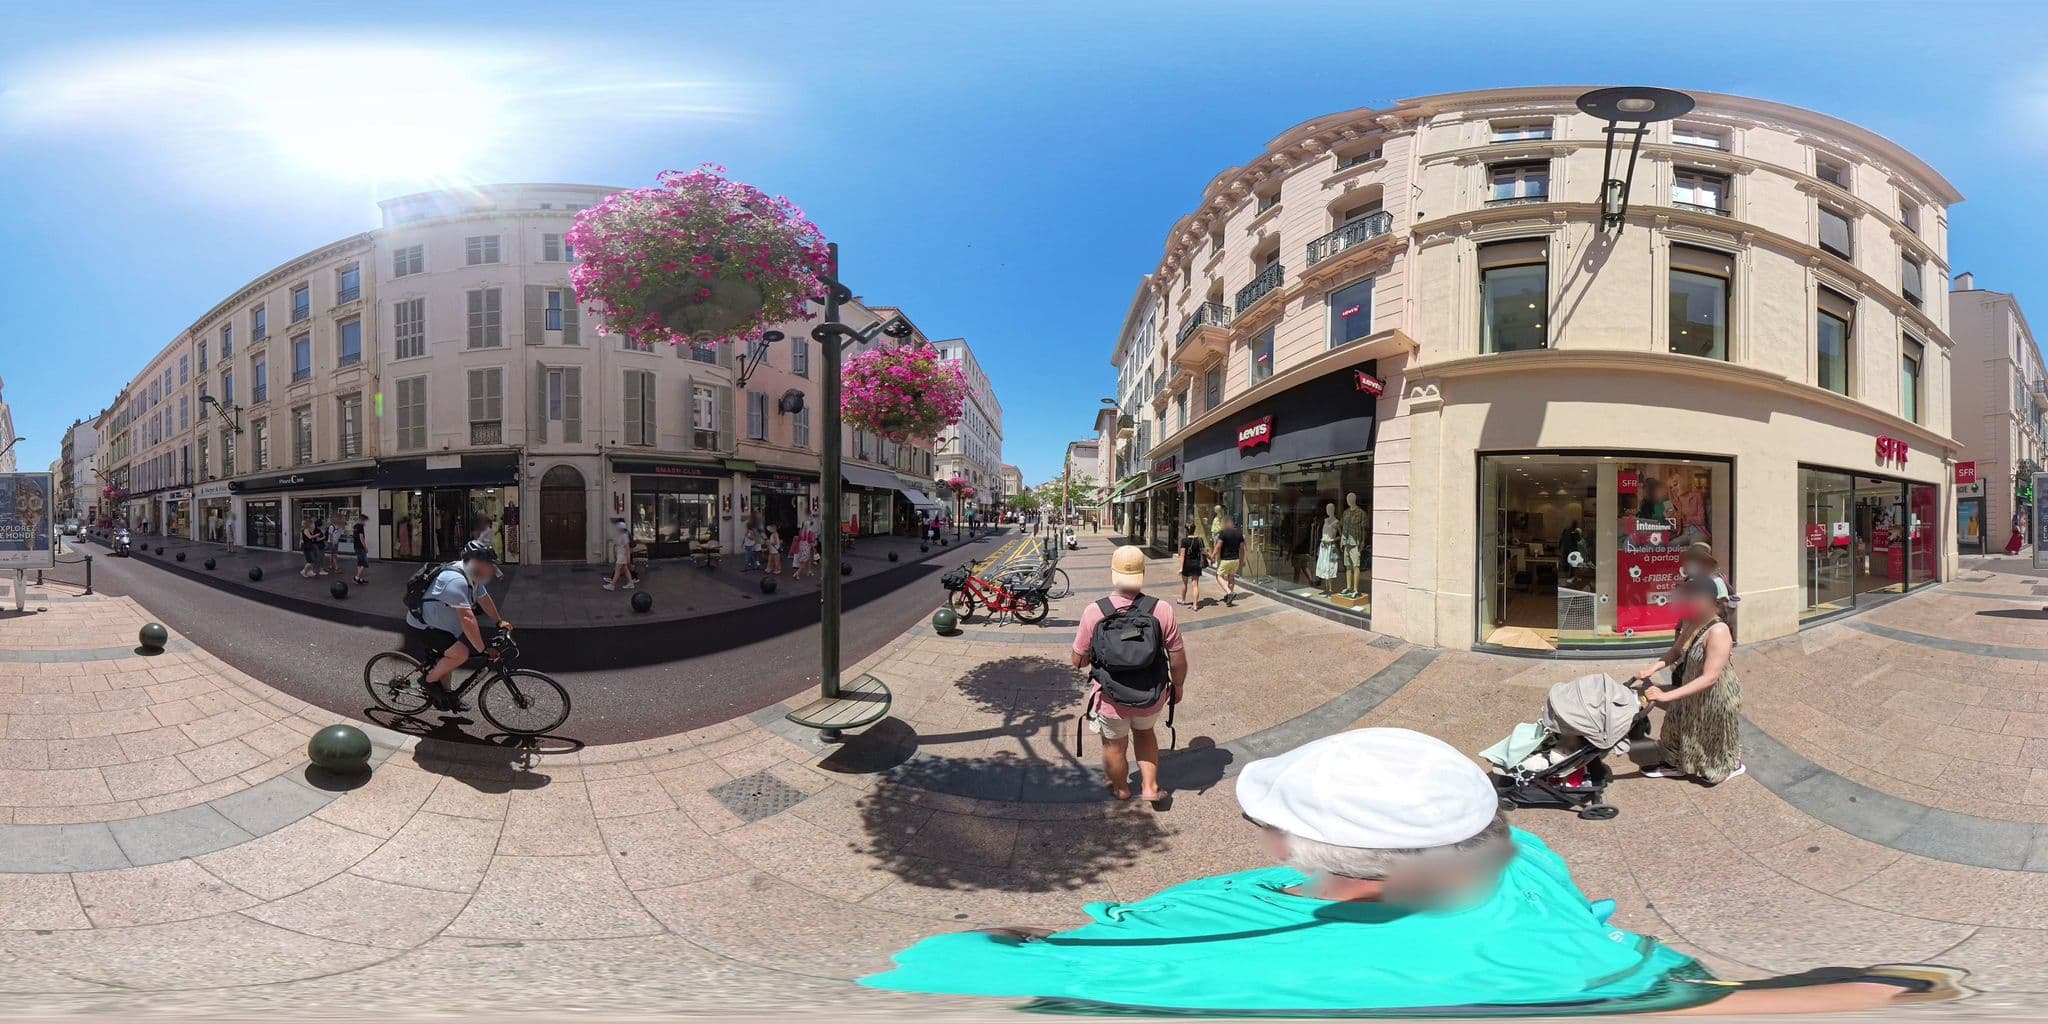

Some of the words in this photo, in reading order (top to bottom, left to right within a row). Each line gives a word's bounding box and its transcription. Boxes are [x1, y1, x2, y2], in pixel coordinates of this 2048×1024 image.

[1876, 435, 1909, 463] SFR
[1958, 468, 1975, 477] SFR
[1622, 479, 1637, 487] SFR
[1651, 554, 1680, 563] partag
[1648, 573, 1673, 582] FIBRE
